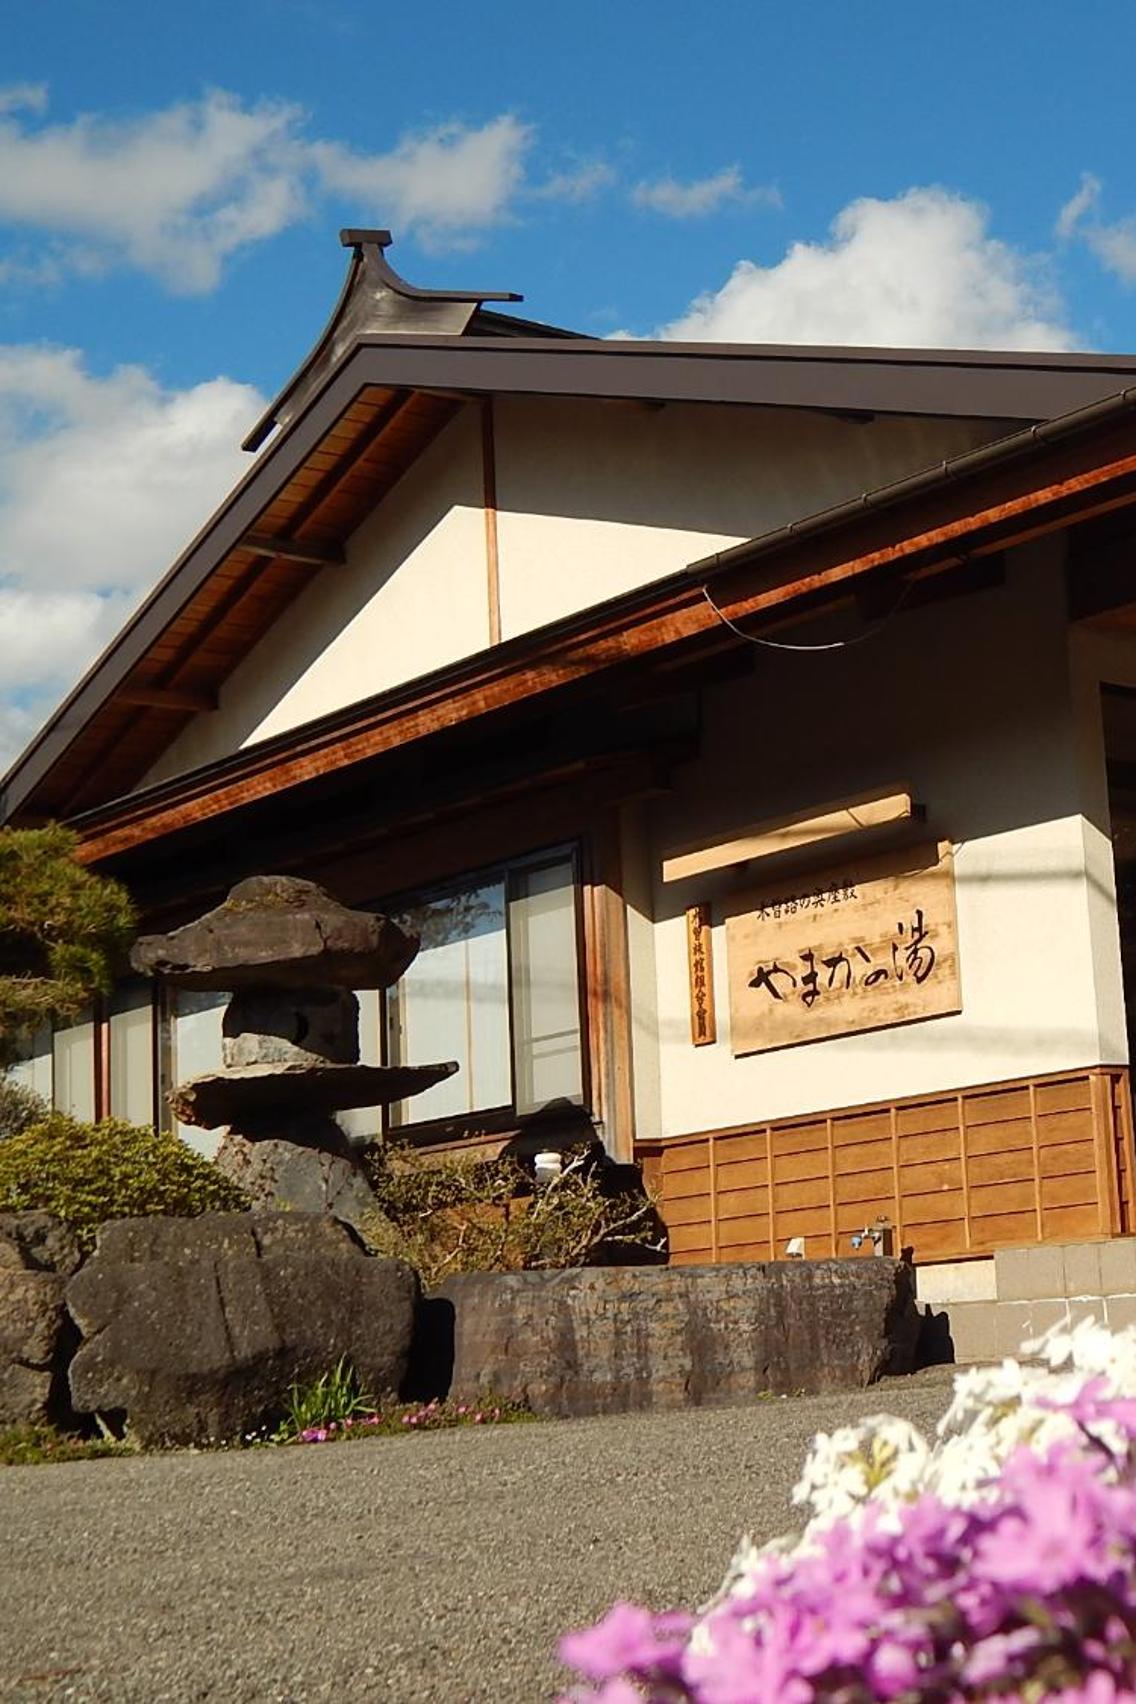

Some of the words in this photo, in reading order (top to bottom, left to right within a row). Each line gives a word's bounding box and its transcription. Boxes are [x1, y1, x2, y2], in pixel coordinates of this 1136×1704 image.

[748, 909, 936, 1008] やまかの湯
